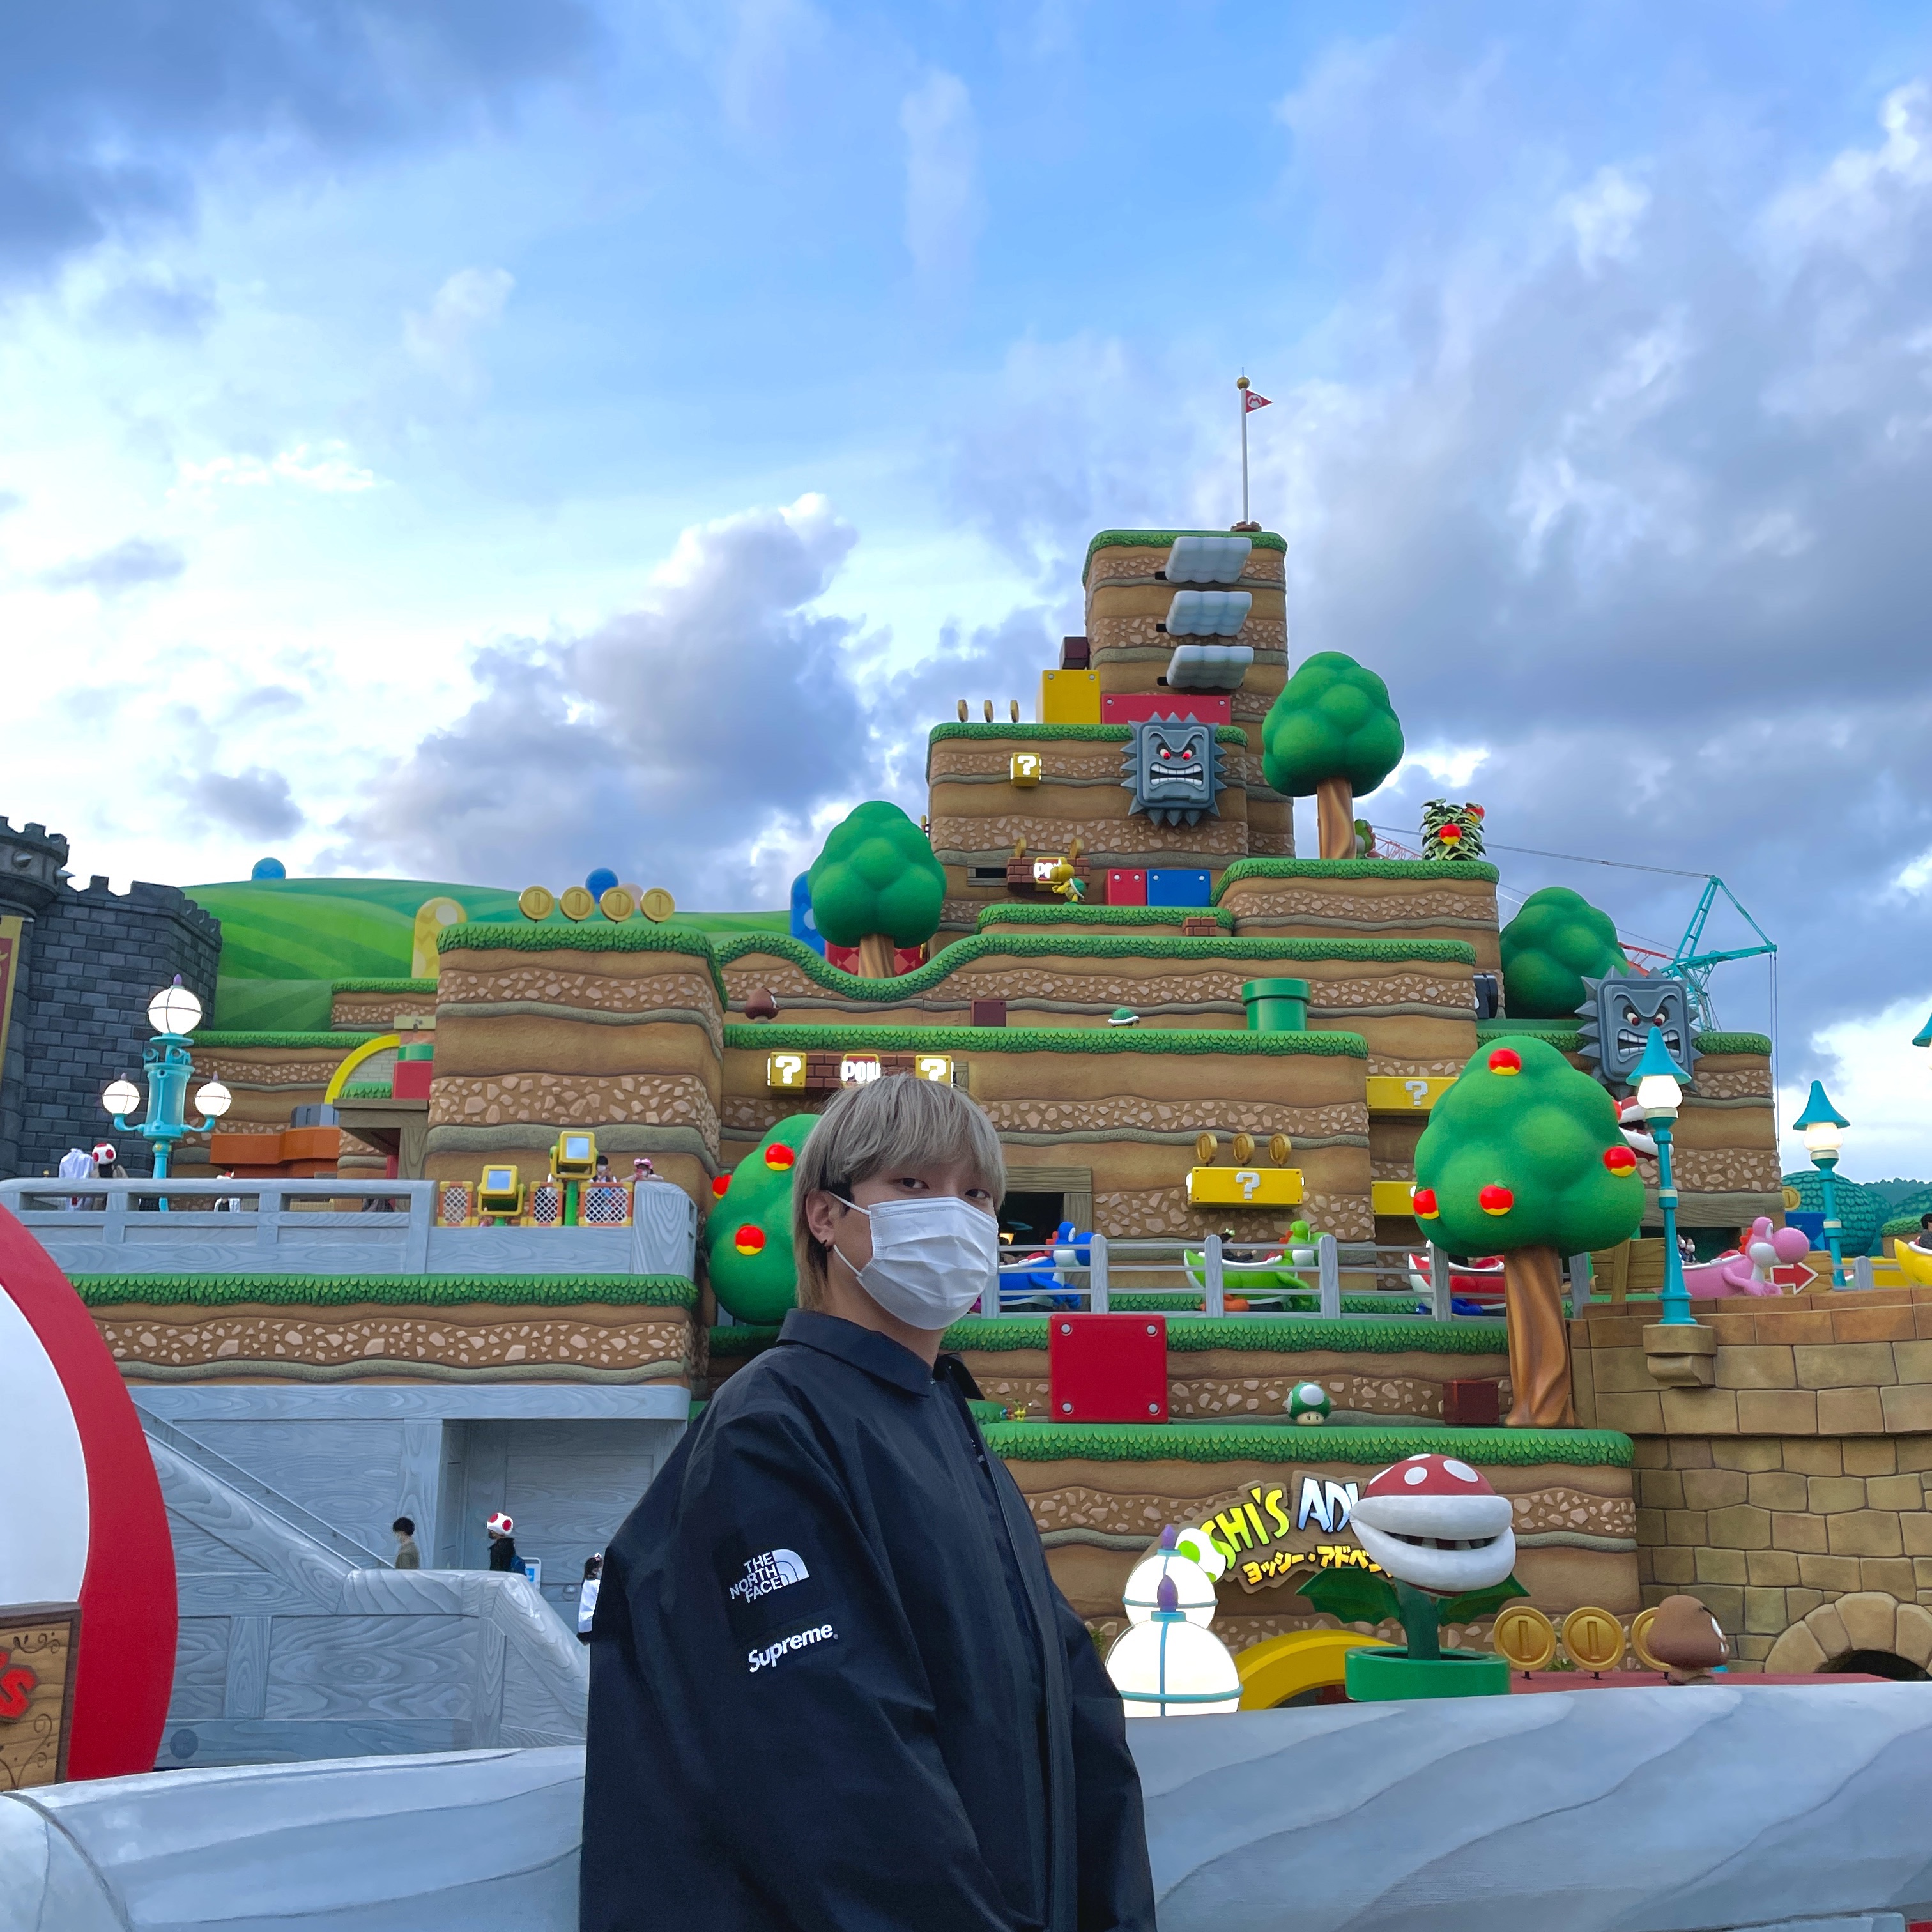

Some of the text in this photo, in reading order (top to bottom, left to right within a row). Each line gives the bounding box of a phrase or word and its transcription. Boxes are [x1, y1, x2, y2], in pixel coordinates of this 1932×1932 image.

[1017, 755, 1036, 776] ?
[775, 1055, 801, 1084] ?
[841, 1061, 881, 1082] POW
[1406, 1080, 1429, 1107] ?
[1236, 1172, 1261, 1200] ?
[1200, 1487, 1289, 1570] SHI'S
[743, 1551, 774, 1574] THE
[1241, 1545, 1393, 1585] ヨッシー・アドベ
[730, 1564, 778, 1599] NORTH
[745, 1576, 783, 1604] FACE
[748, 1624, 833, 1673] Supreme
